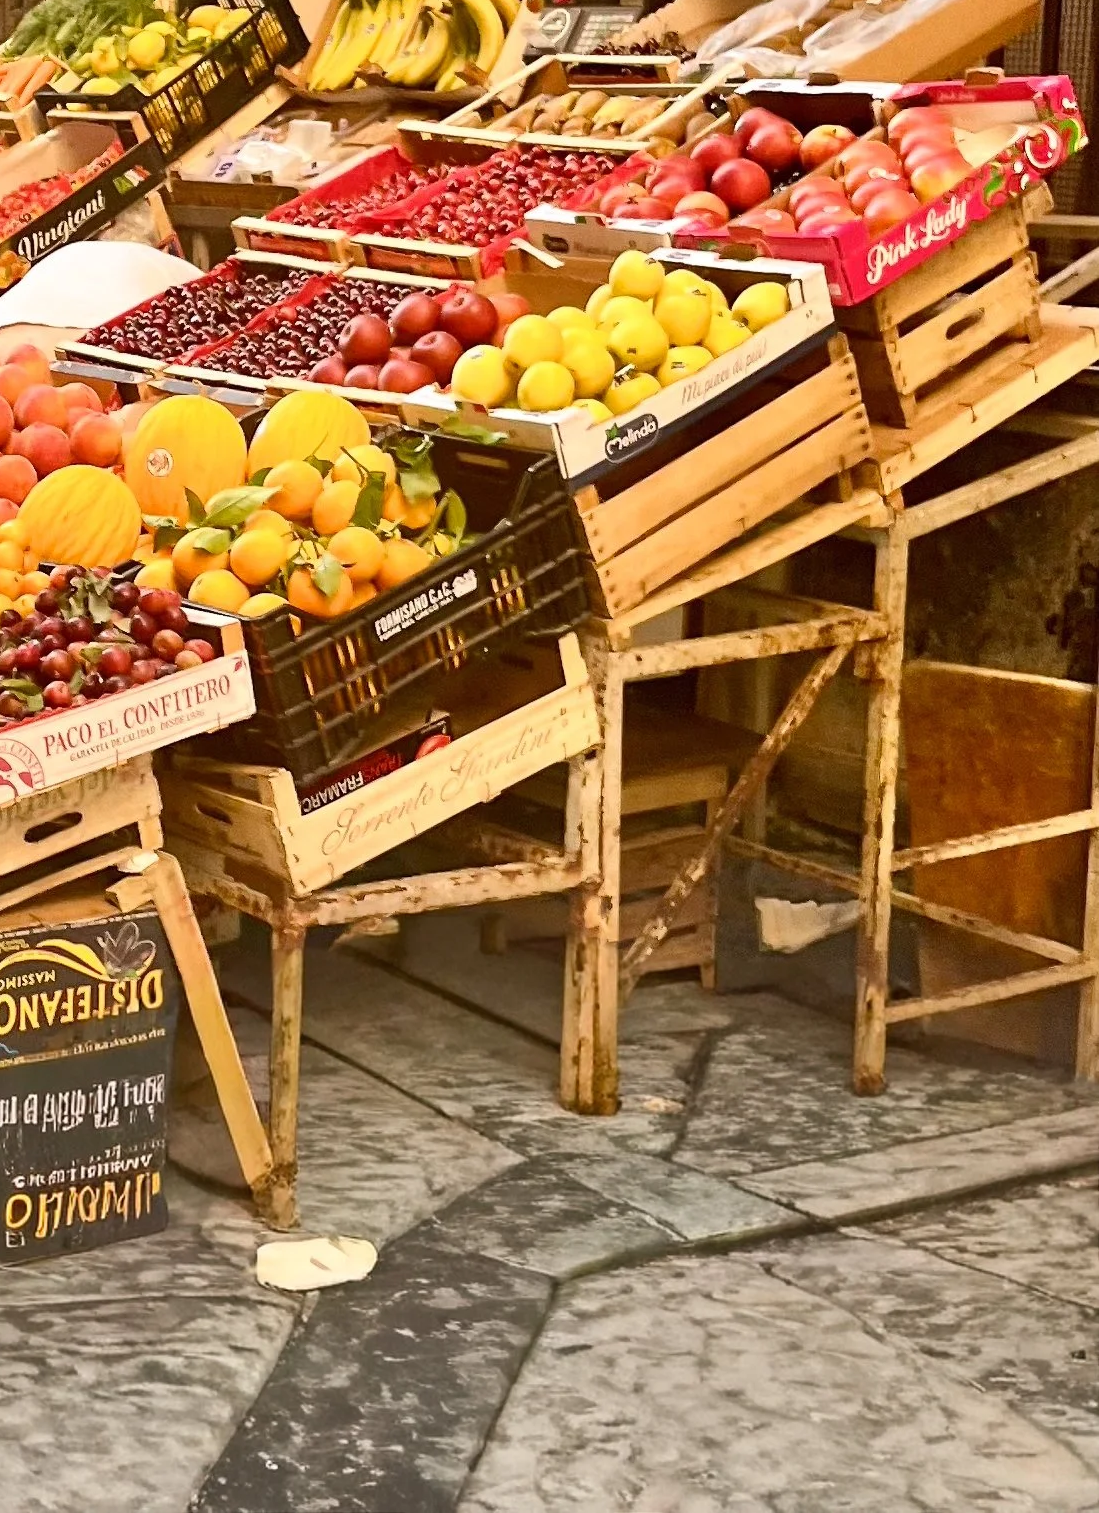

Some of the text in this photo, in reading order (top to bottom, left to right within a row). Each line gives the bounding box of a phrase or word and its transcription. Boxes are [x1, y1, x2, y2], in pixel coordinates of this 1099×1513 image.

[18, 189, 106, 262] Vingiani
[866, 196, 967, 285] Pink Lady
[606, 419, 657, 456] Melinda
[374, 593, 429, 636] FORMISANO
[42, 674, 231, 757] PACO EL CONFITERO
